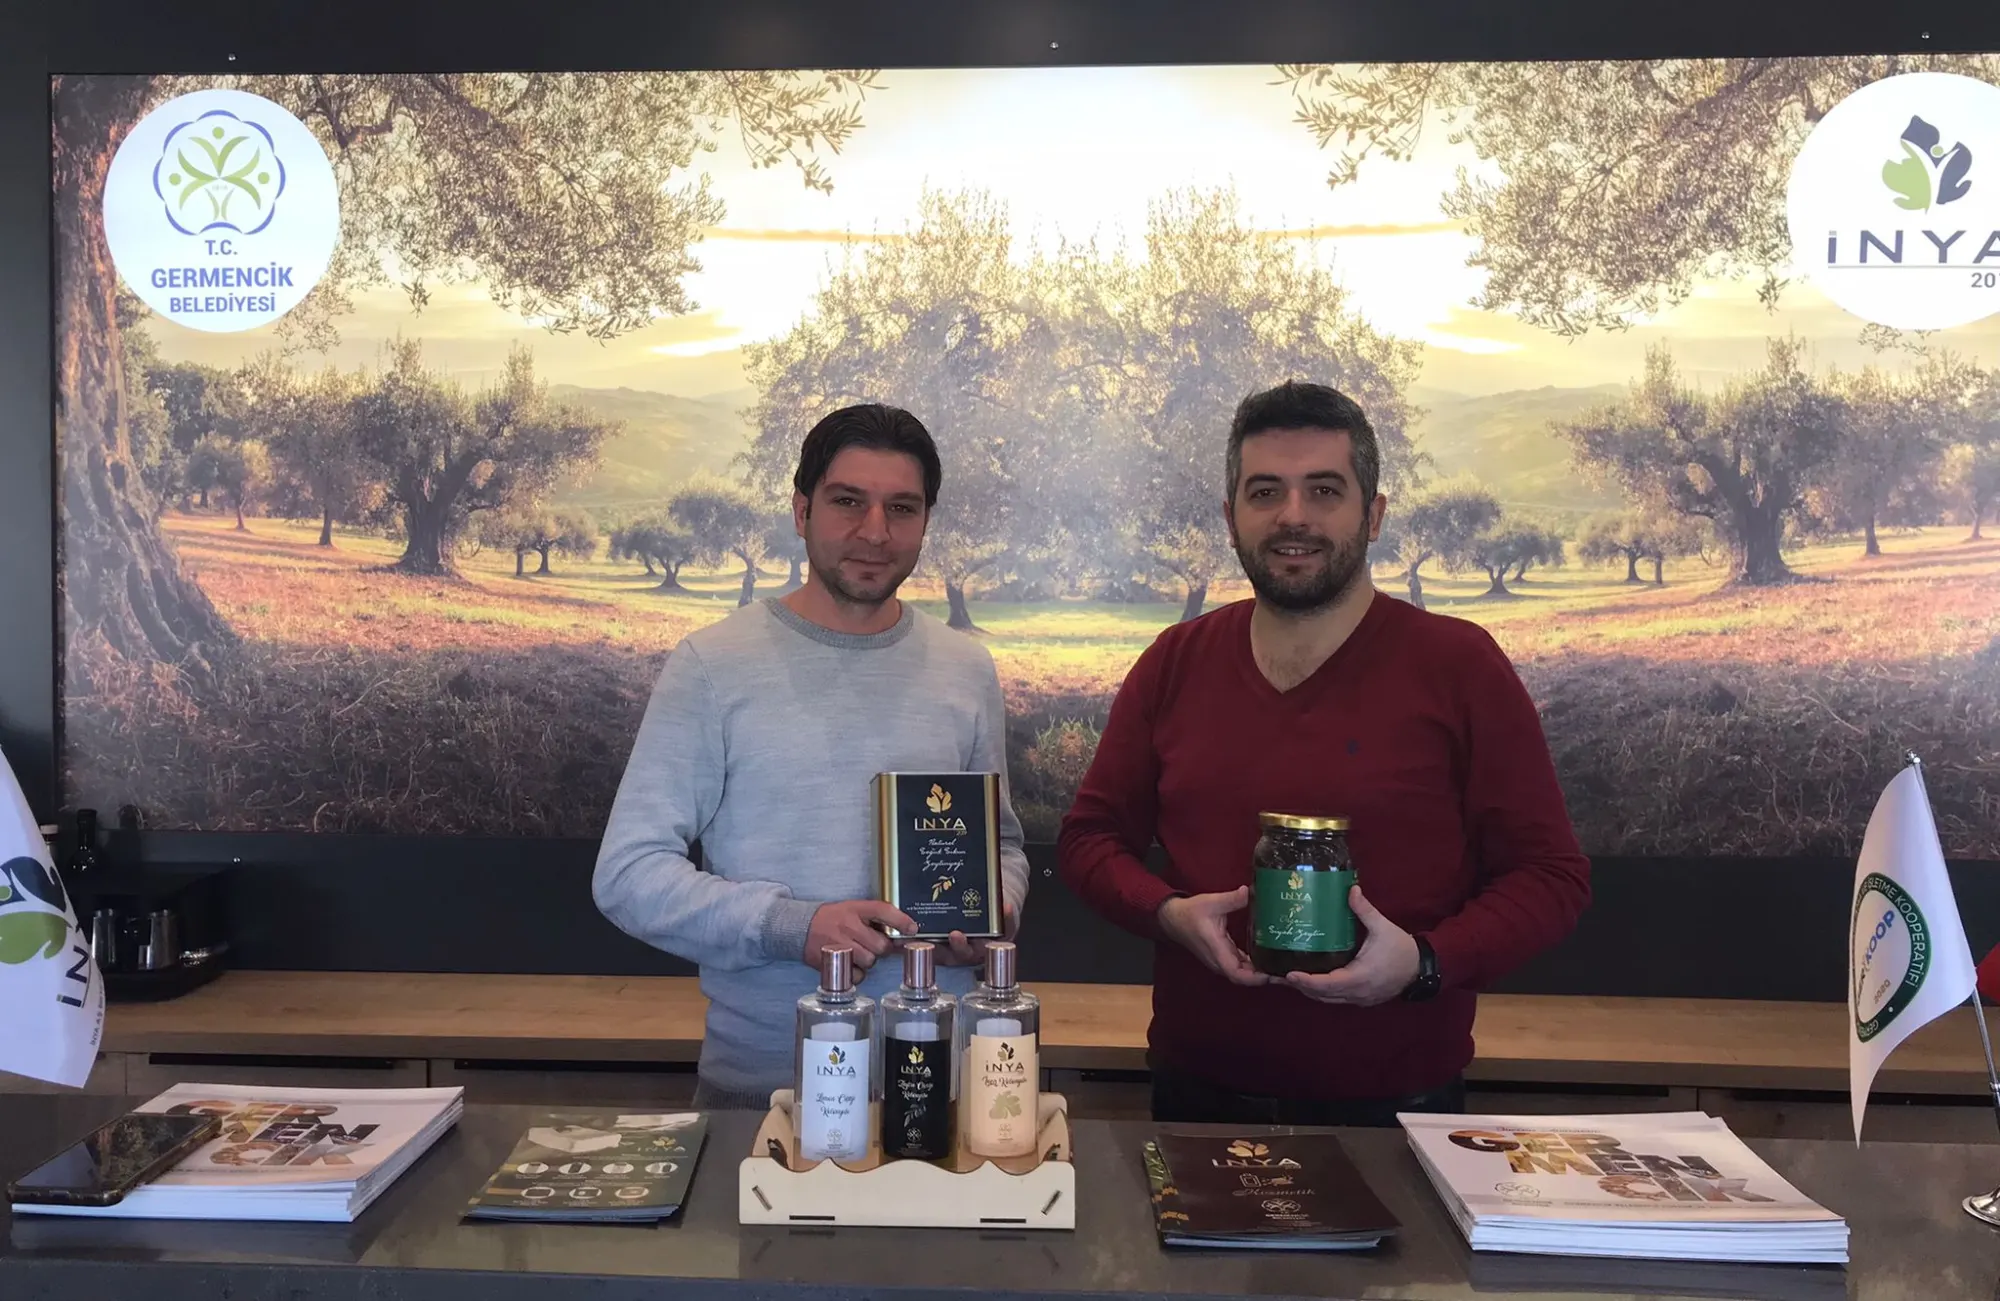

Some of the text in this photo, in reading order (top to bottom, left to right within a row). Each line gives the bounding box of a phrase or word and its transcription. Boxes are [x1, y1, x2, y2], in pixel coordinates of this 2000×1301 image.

[204, 239, 238, 256] T.C.
[151, 262, 294, 288] GERMENCİK
[1971, 272, 2000, 288] 20
[170, 292, 275, 313] BELEDİYESİ
[1894, 895, 1925, 987] KOOPERATİFİ
